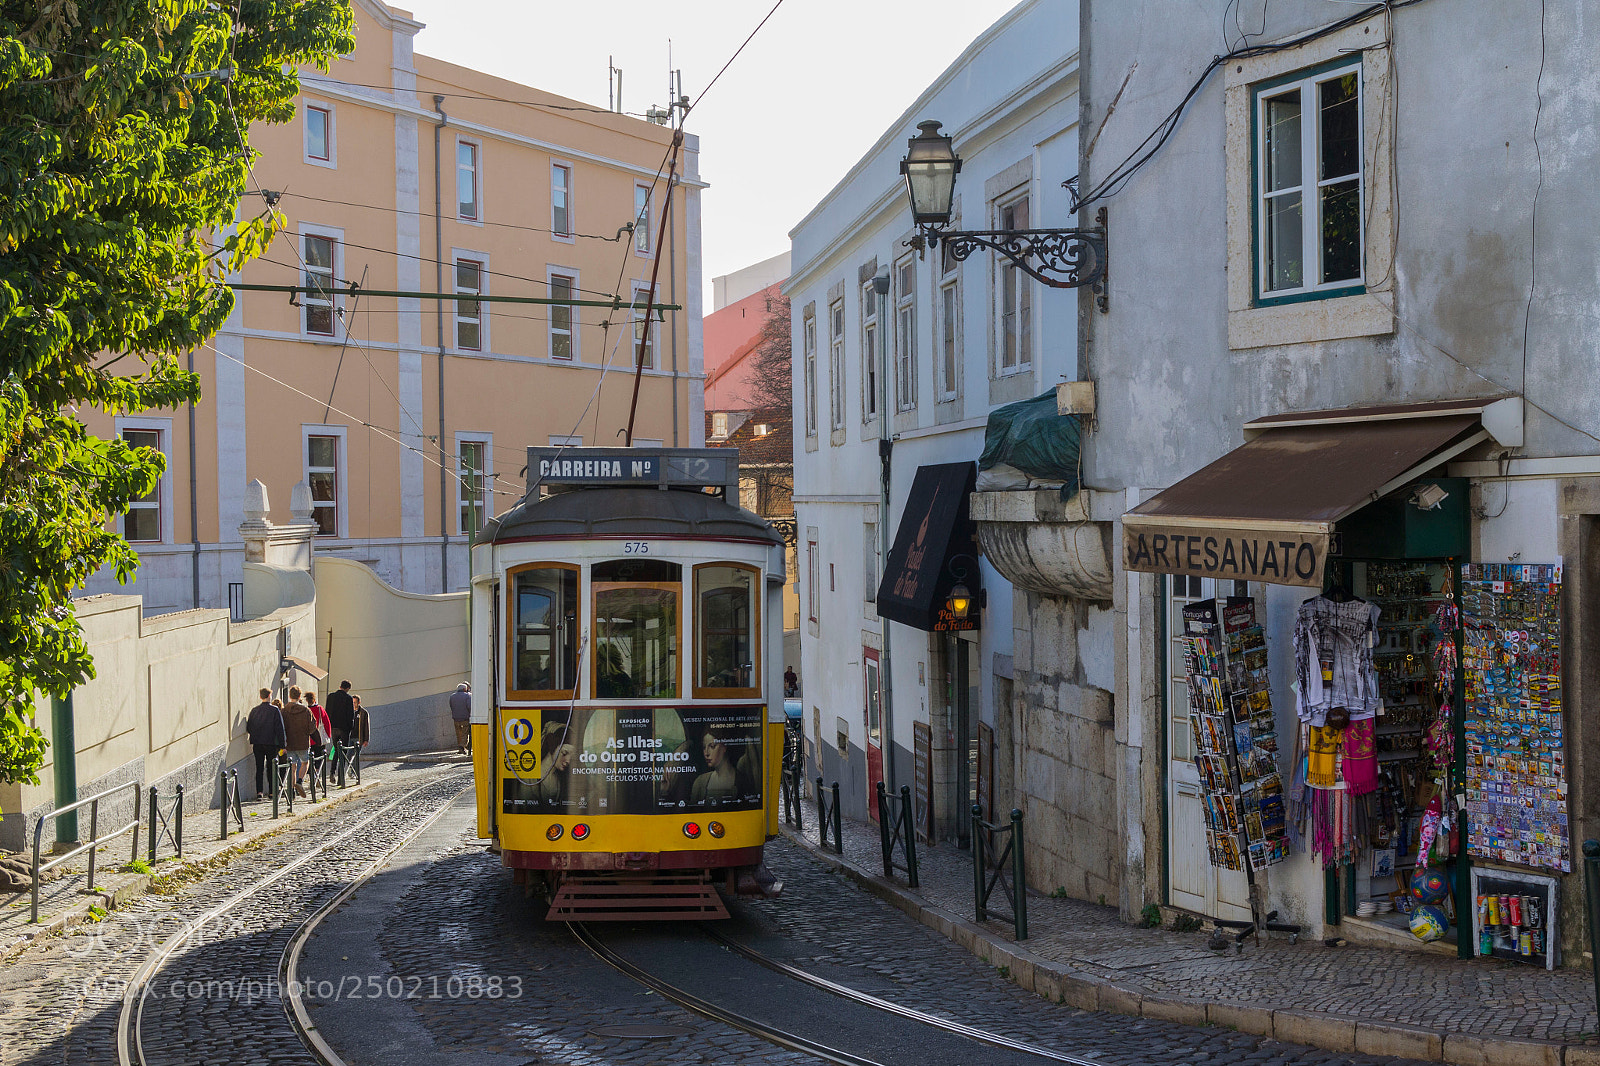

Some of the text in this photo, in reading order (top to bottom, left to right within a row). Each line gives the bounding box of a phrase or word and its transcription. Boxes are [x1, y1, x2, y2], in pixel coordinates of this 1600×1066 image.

[540, 458, 710, 480] CARREIRA Nº 12
[624, 542, 649, 553] 575
[1133, 533, 1316, 580] ARTESANATO
[934, 621, 947, 631] do
[606, 735, 663, 748] As Ilhas
[579, 750, 689, 763] do Ouro Branco
[572, 765, 697, 775] ENCOMENDA ARTÍSTICA NA MADEIRA
[606, 774, 664, 782] SÉCULOS XV-XVI
